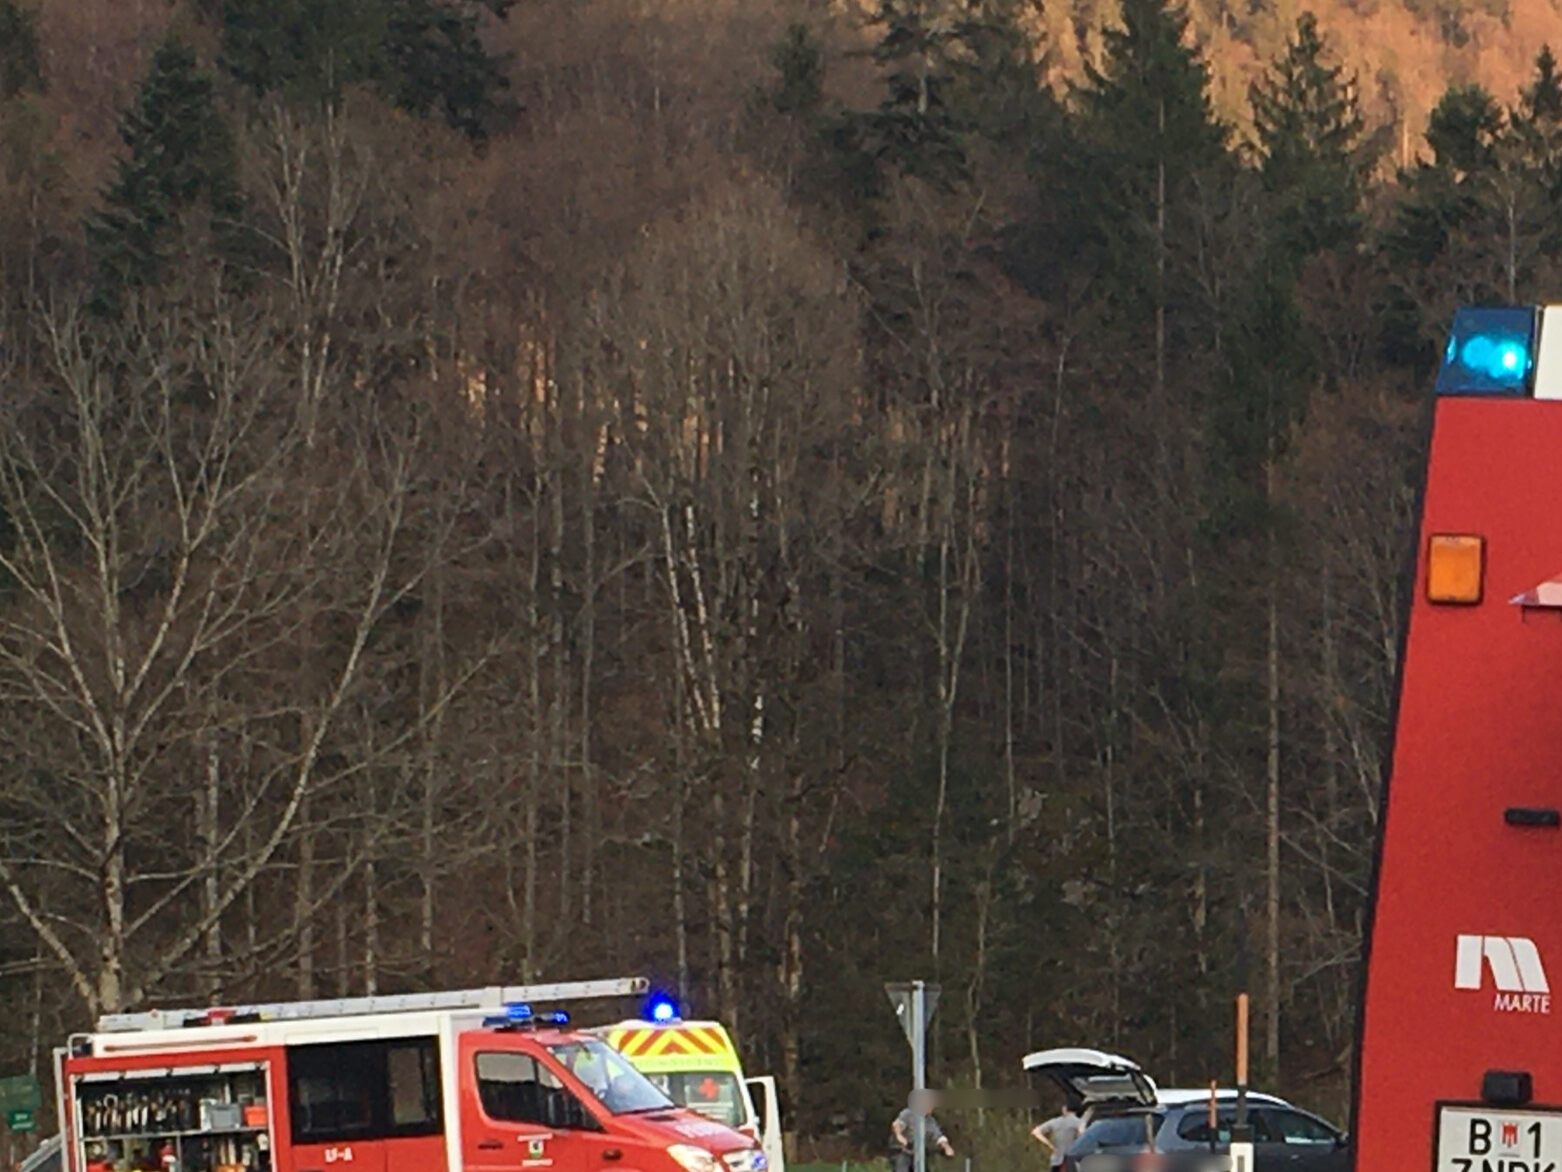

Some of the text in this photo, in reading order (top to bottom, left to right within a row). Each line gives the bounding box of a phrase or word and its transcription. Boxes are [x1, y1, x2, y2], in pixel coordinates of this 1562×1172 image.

[1494, 993, 1551, 1013] MARTE
[1469, 1118, 1541, 1159] B 1
